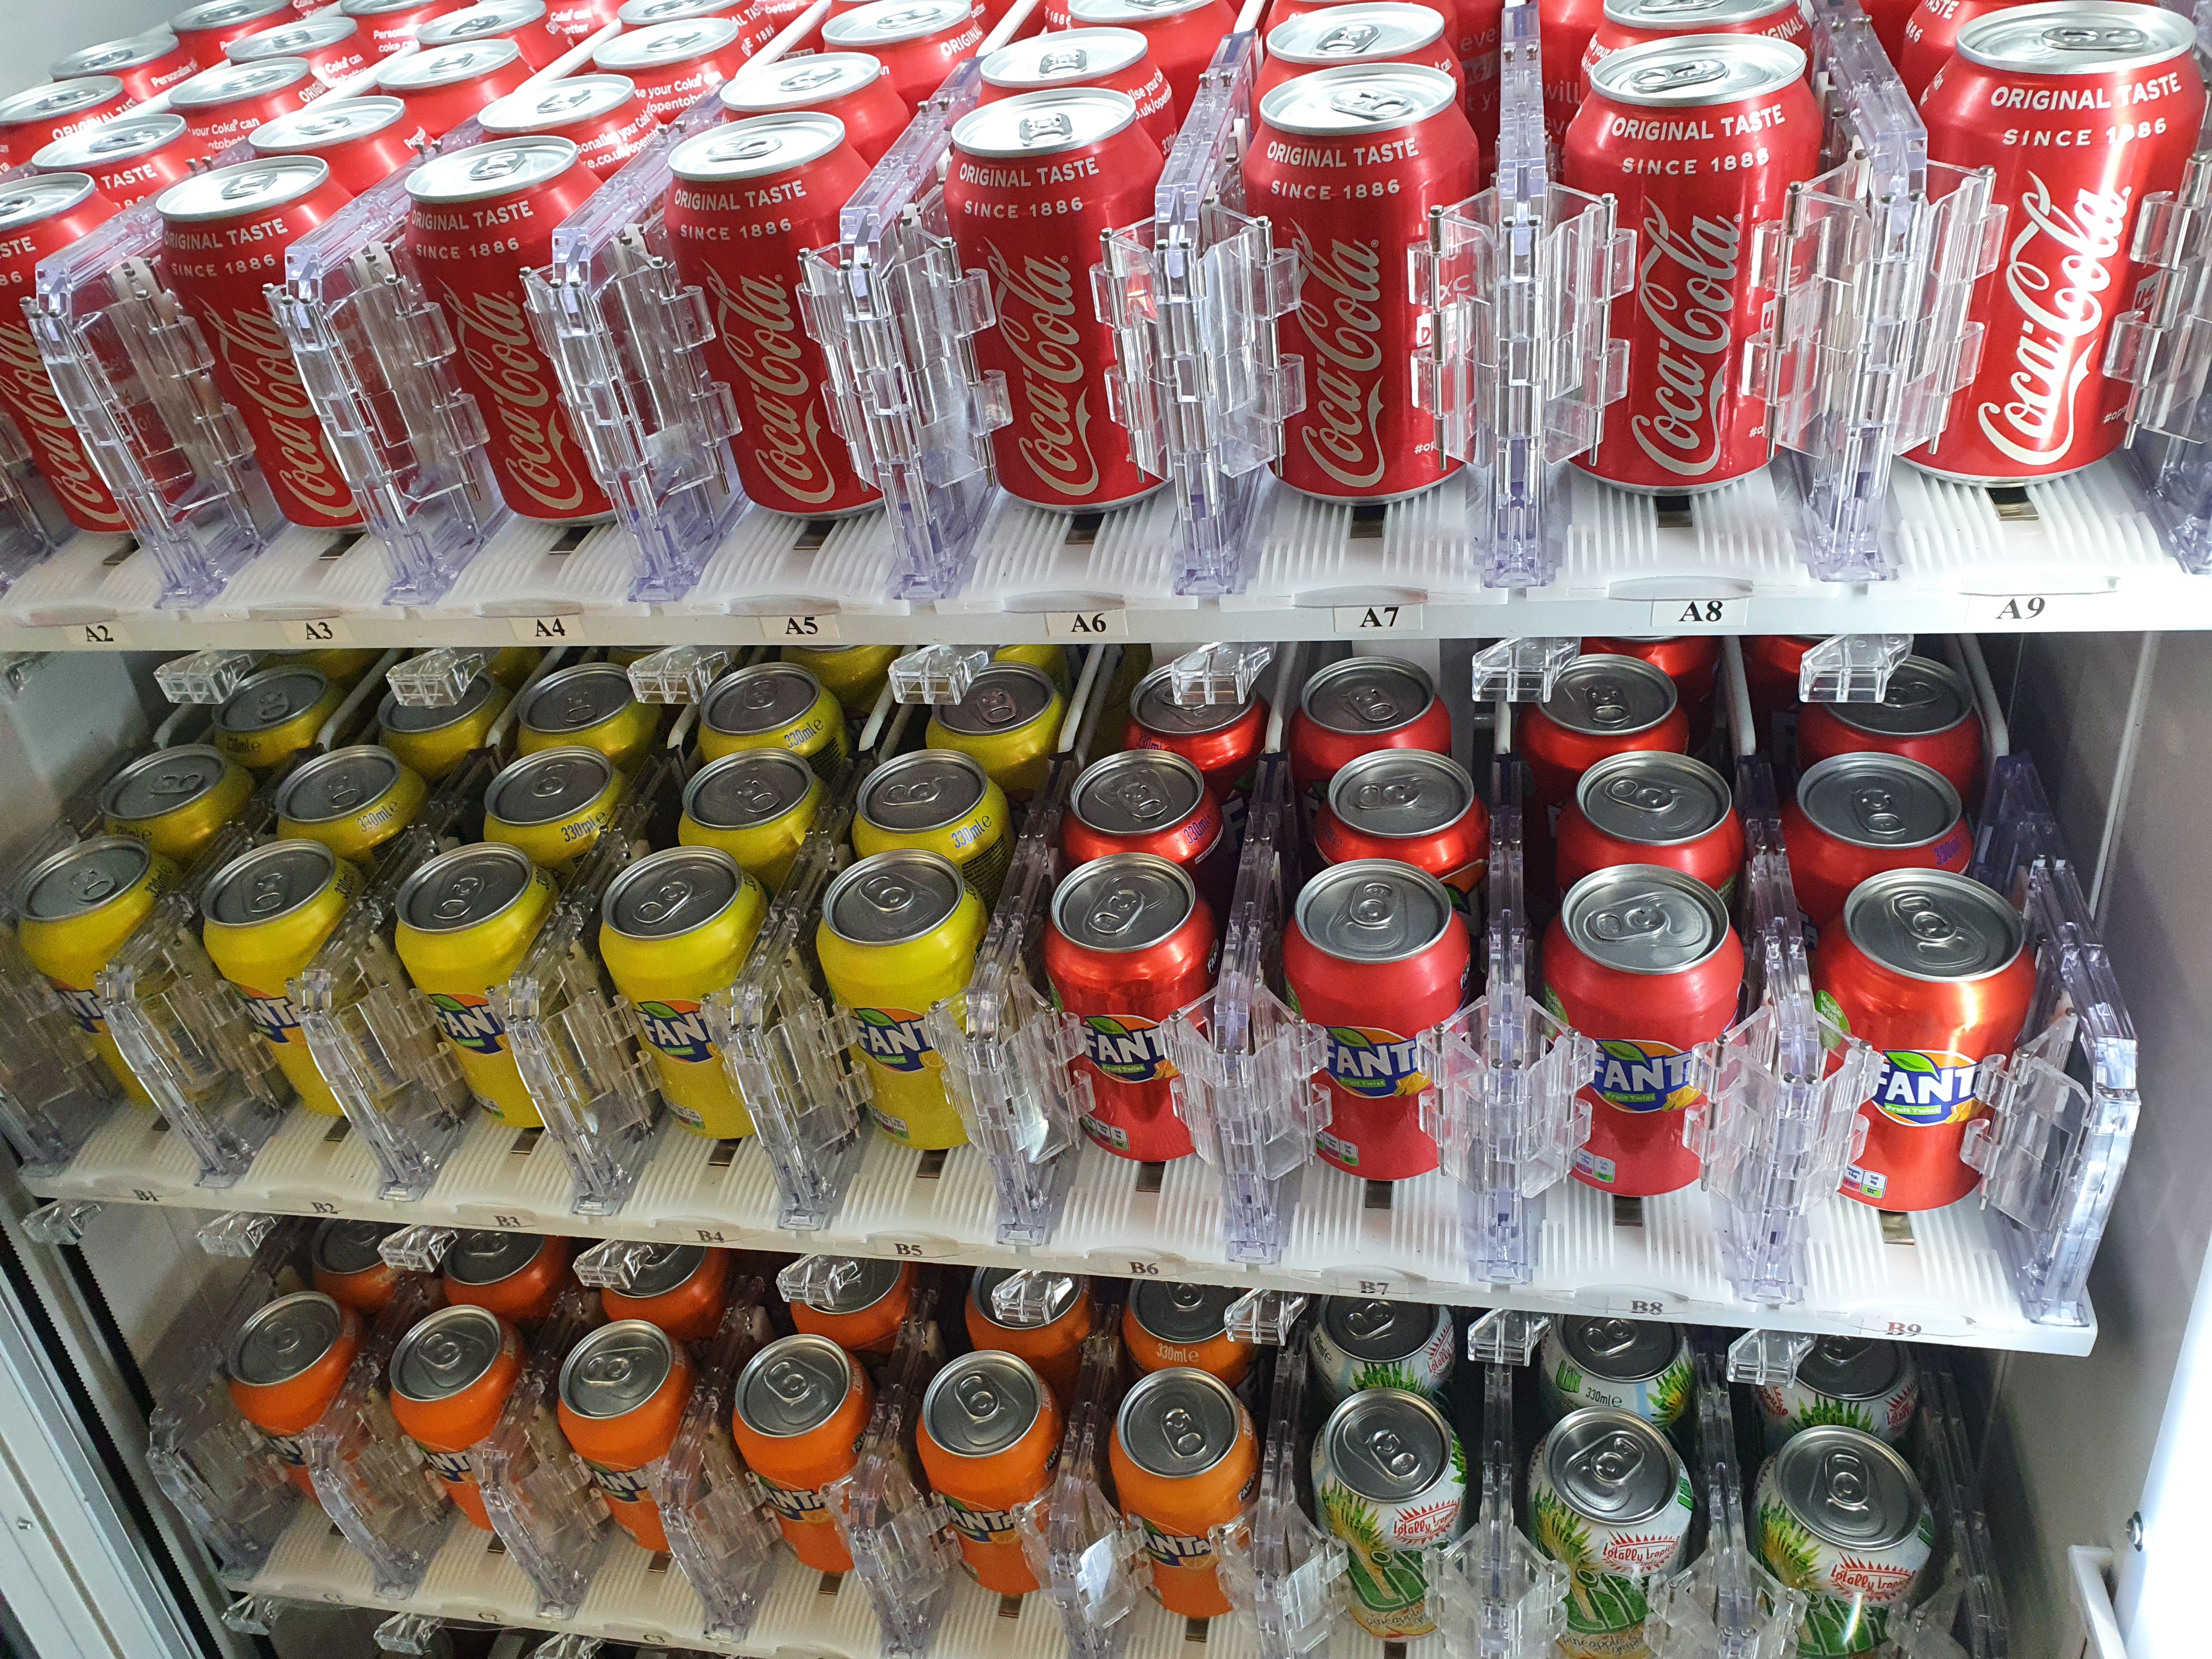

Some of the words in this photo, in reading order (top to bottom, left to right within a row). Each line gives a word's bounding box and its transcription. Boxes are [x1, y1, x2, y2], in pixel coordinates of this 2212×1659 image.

[648, 84, 672, 100] your
[1991, 86, 2111, 110] ORIGINAL
[2117, 71, 2182, 107] TASTE
[240, 117, 261, 130] can
[1612, 117, 1714, 142] ORIGINAL
[1720, 103, 1786, 138] TASTE
[2002, 128, 2092, 147] SINCE
[2106, 117, 2168, 144] 1886
[1267, 140, 1346, 167] ORIGINAL
[1353, 136, 1420, 166] TASTE
[1622, 157, 1697, 175] SINCE
[1712, 147, 1769, 173] 1886
[100, 163, 157, 190] TASTE
[959, 162, 1031, 188] ORIGINAL
[1036, 156, 1099, 186] TASTE
[674, 189, 741, 211] ORIGINAL
[744, 179, 807, 207] TASTE
[1271, 180, 1331, 200] SINCE
[1343, 178, 1400, 200] 1886
[411, 208, 470, 232] ORIGINAL
[473, 200, 534, 228] TASTE
[964, 200, 1019, 219] SINCE
[1029, 196, 1084, 217] 1886
[226, 217, 289, 246] TASTE
[680, 224, 731, 241] SINCE
[740, 218, 792, 238] 1886
[0, 236, 36, 258] STE
[415, 242, 461, 260] SINCE
[469, 236, 520, 257] 1886
[172, 262, 218, 278] SINCE
[224, 253, 276, 274] 1886
[1359, 606, 1400, 628] A7
[1678, 600, 1724, 622] A8
[1995, 597, 2046, 620] A9
[85, 624, 115, 643] A2
[303, 622, 334, 641] A3
[534, 618, 567, 637] A4
[784, 616, 819, 636] A5
[1070, 612, 1107, 634] A6
[438, 1006, 504, 1038] FANT
[634, 1009, 713, 1046] FANT
[856, 1018, 934, 1055] FANT
[1083, 1026, 1164, 1064] FANT
[1318, 1036, 1417, 1077] FANT
[1590, 1051, 1691, 1092] FANT
[1876, 1064, 1976, 1104] FANT
[1885, 1105, 1911, 1114] Fruit
[1913, 1105, 1941, 1115] Twist
[133, 1188, 160, 1203] B1
[311, 1200, 339, 1215] B2
[494, 1214, 522, 1228] B3
[697, 1229, 725, 1244] B4
[895, 1243, 923, 1257] B5
[1129, 1261, 1160, 1276] B6
[1358, 1280, 1390, 1295] B7
[1629, 1300, 1664, 1316] B8
[1887, 1321, 1922, 1336] B9
